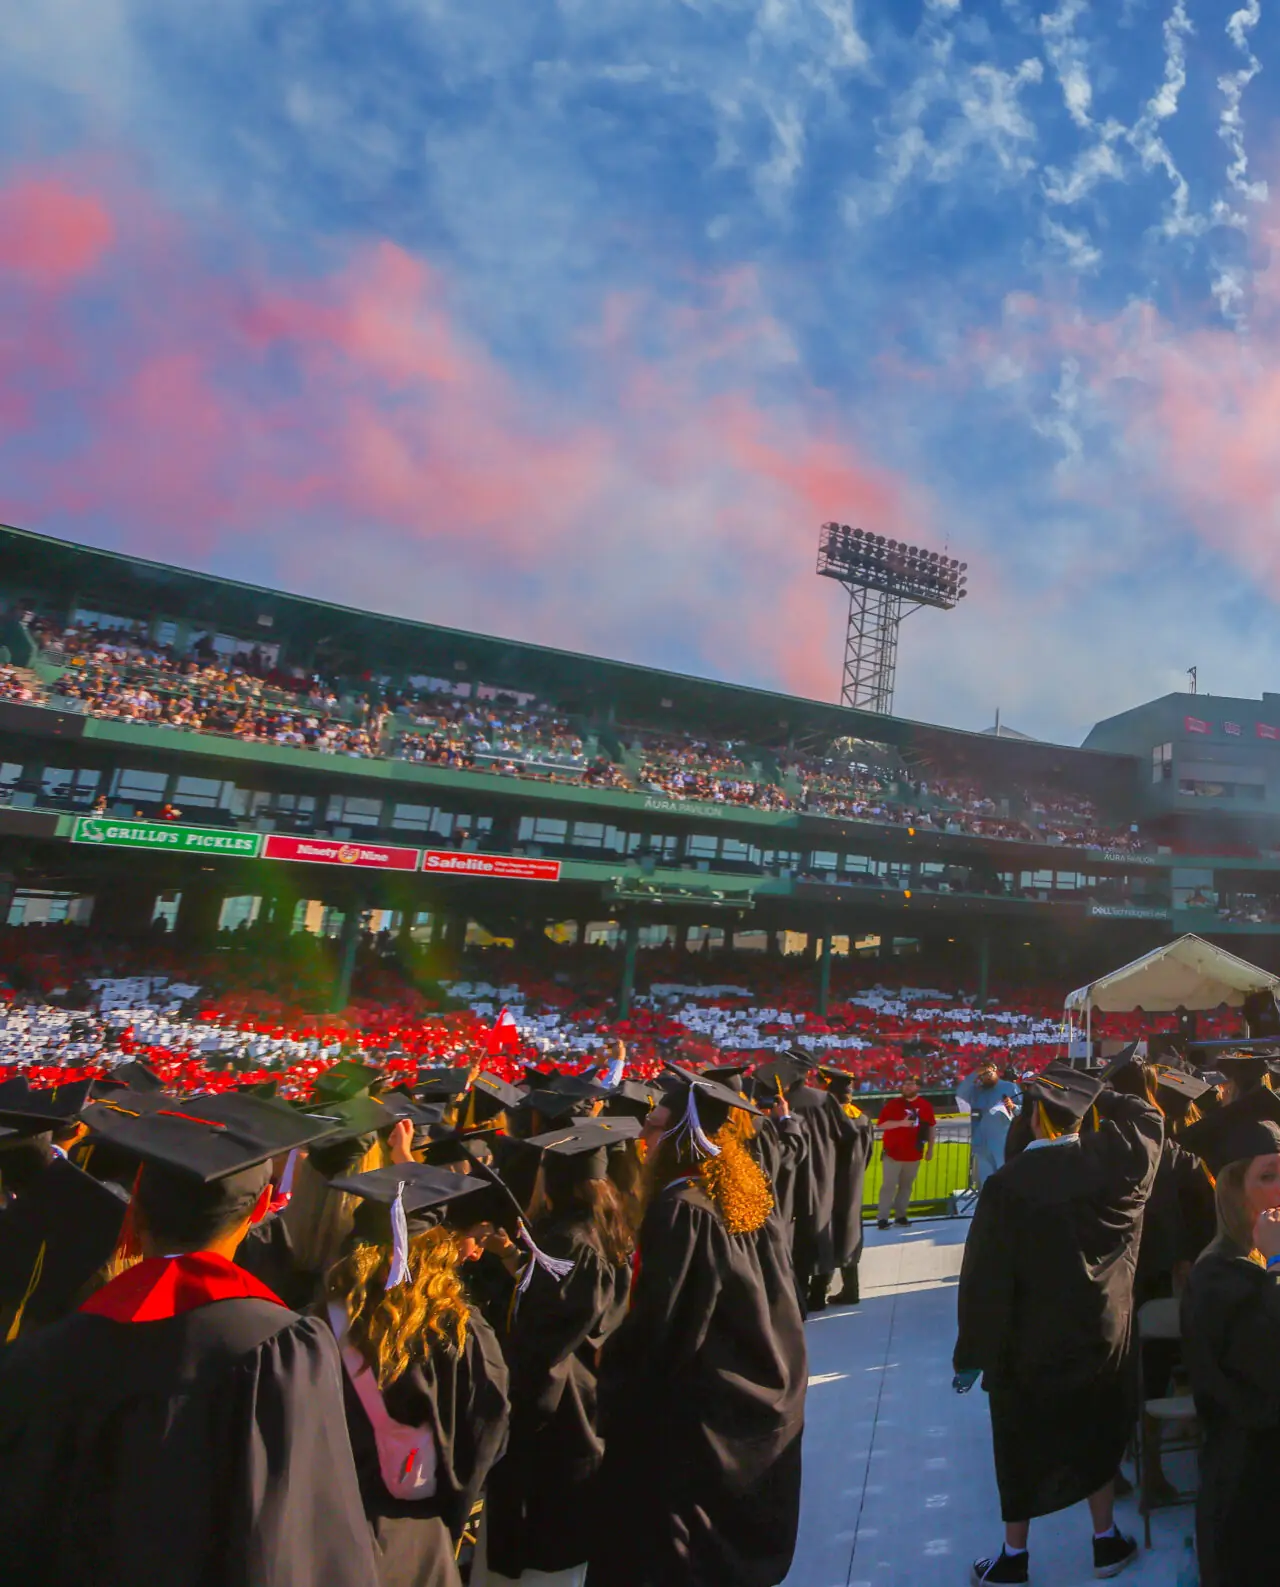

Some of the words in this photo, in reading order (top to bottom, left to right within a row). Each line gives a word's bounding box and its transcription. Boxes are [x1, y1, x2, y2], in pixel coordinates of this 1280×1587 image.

[106, 827, 179, 843] GRILLO'S
[185, 834, 253, 850] PICKLES
[359, 850, 389, 862] Nine
[427, 856, 493, 871] Safelite
